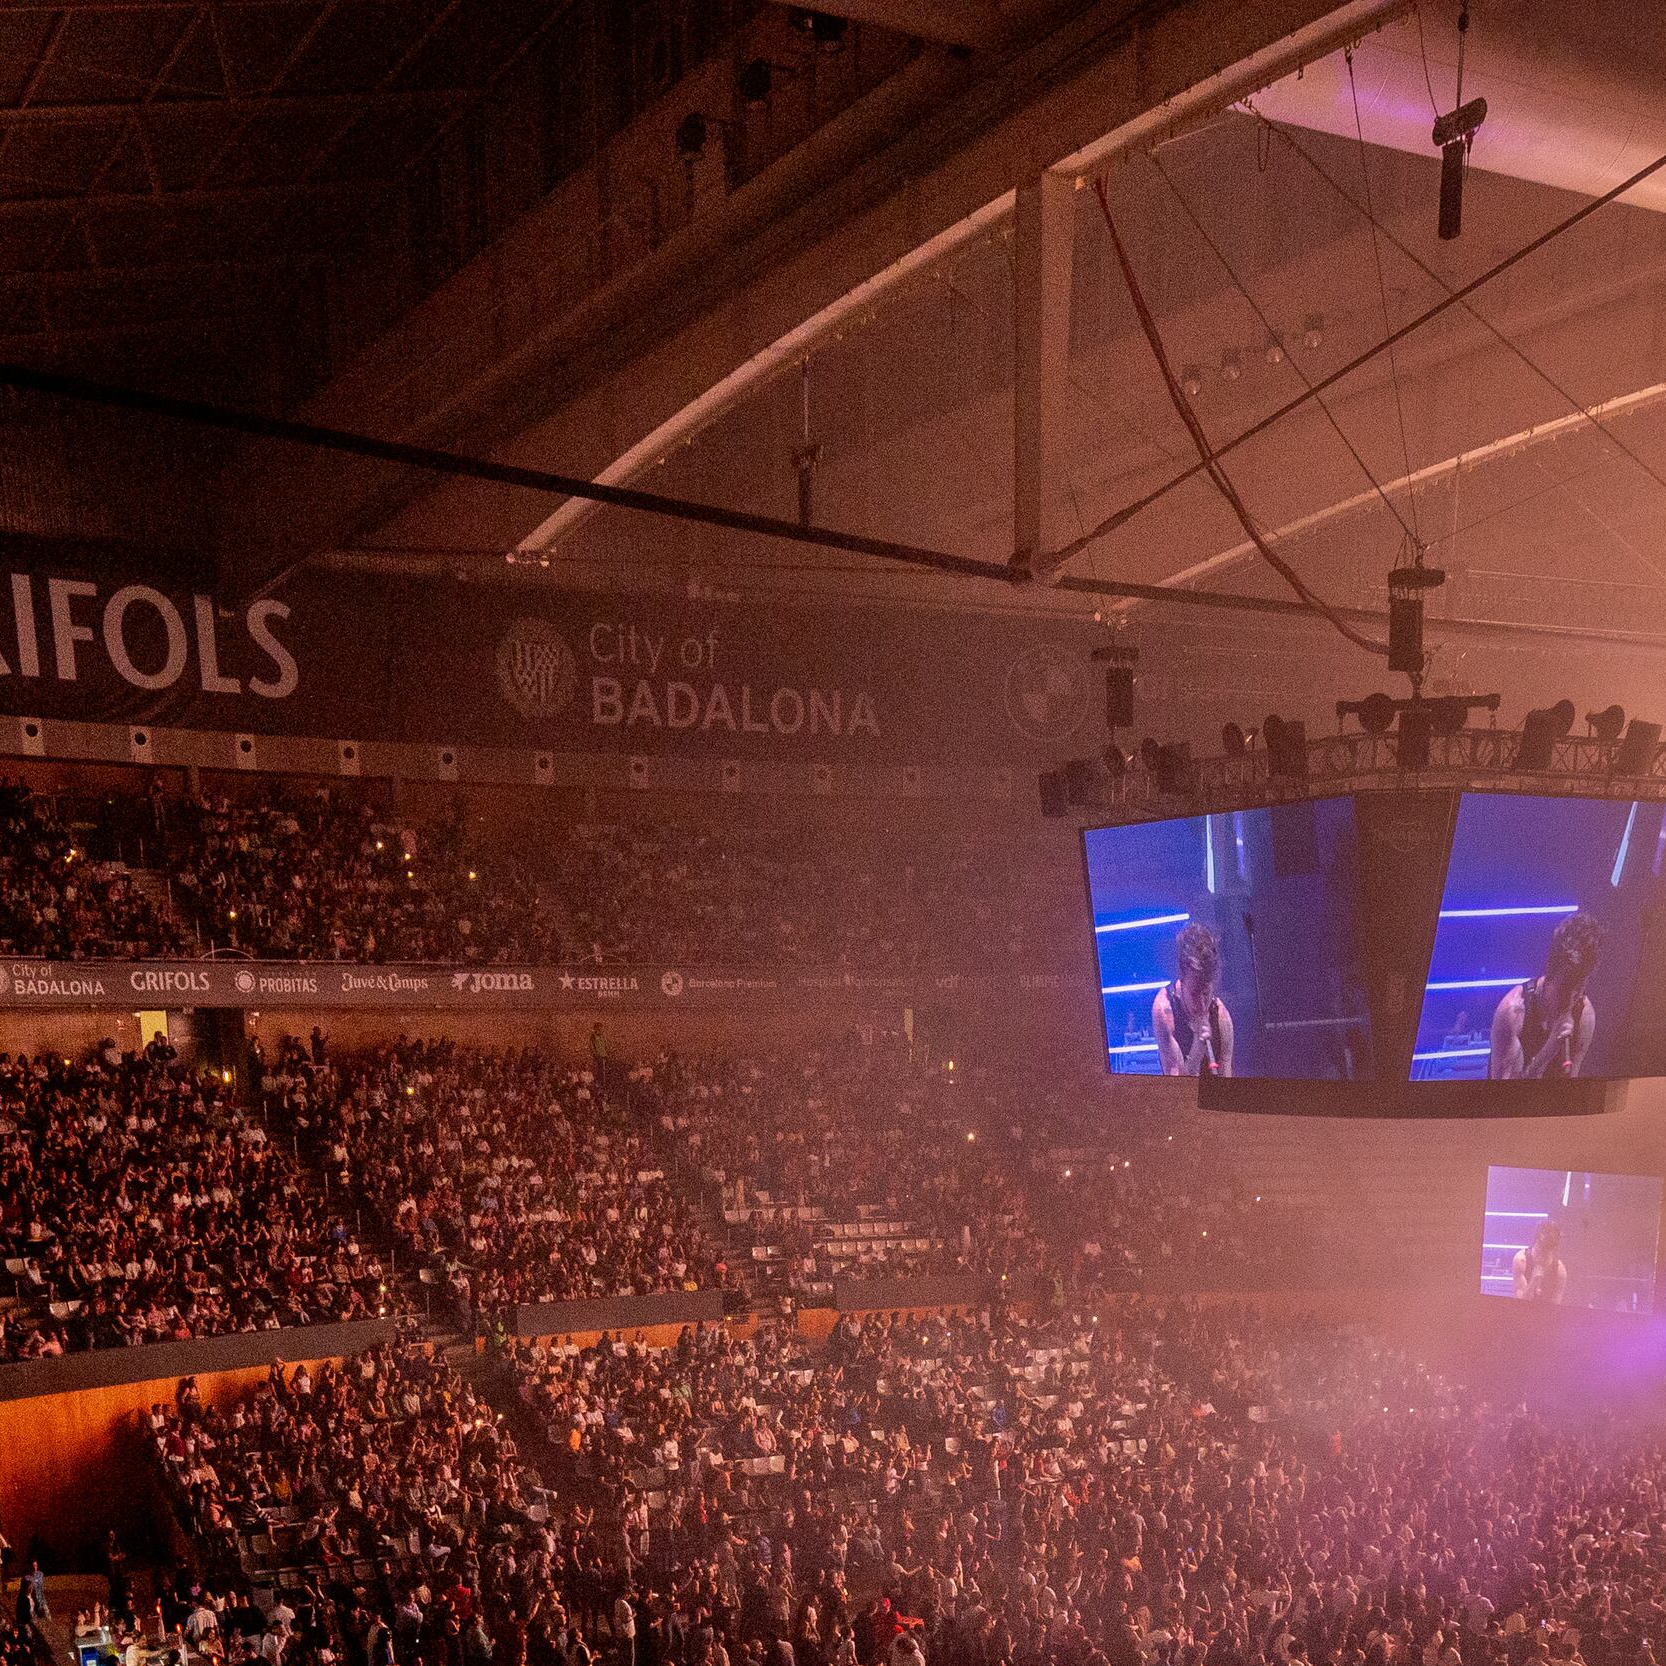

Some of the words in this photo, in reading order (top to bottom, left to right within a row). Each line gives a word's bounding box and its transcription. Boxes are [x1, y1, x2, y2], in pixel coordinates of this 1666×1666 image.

[589, 622, 664, 674] City
[683, 628, 718, 669] of
[592, 677, 881, 737] BADALONA
[12, 964, 37, 979] City
[40, 964, 53, 977] of
[14, 980, 105, 995] BADALONA
[130, 971, 211, 992] GRIFOLS
[259, 978, 318, 993] PROBITAS
[341, 972, 375, 992] Juvé
[388, 972, 429, 993] Camps
[578, 977, 639, 991] ESTRELLA
